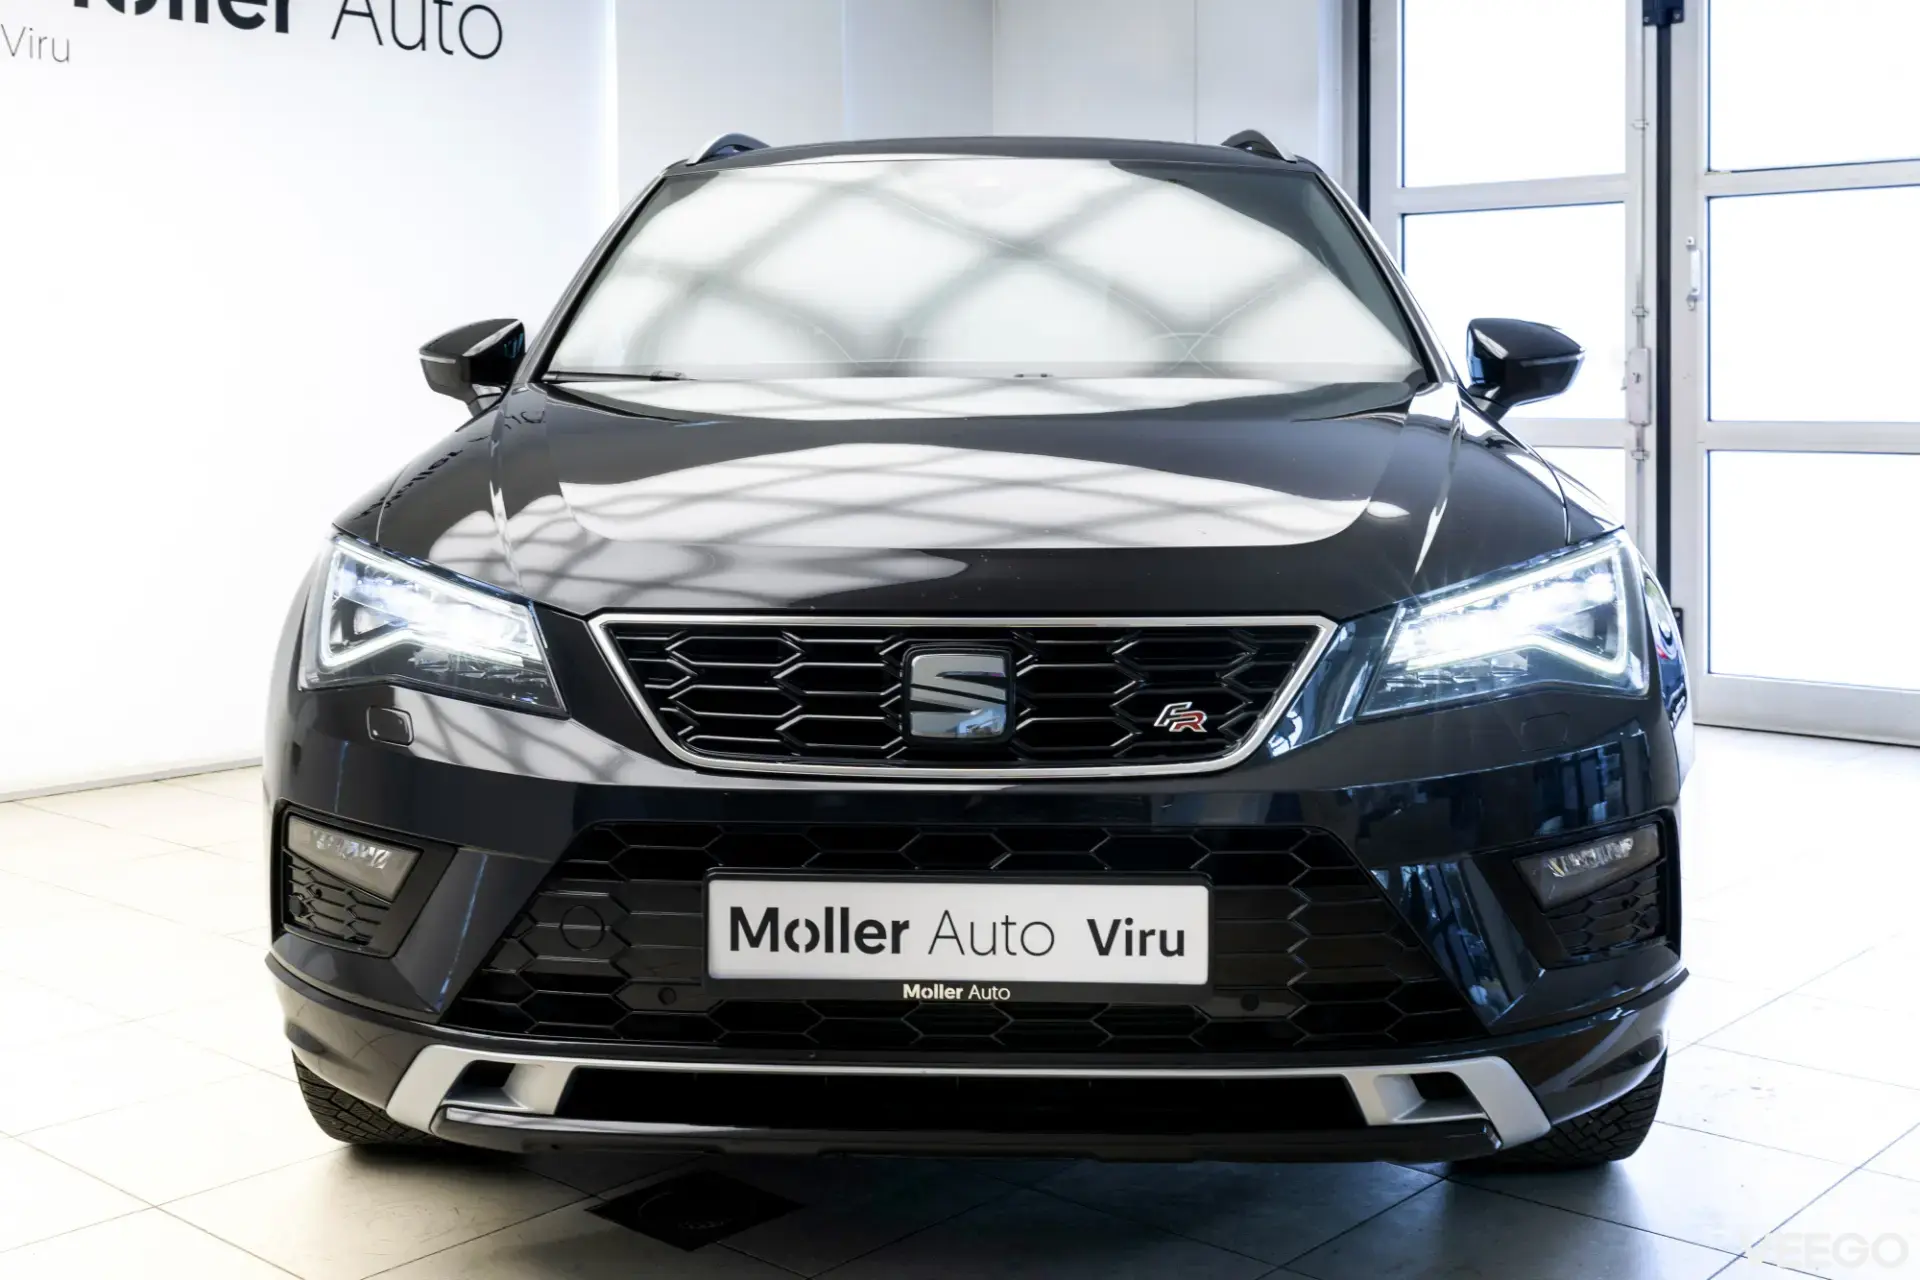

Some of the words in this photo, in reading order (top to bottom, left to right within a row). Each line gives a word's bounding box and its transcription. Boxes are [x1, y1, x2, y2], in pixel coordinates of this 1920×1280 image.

[1, 24, 70, 62] Viru
[1154, 701, 1208, 733] FR
[928, 910, 1055, 957] Auto
[1087, 918, 1185, 958] Viru
[967, 984, 1011, 1001] Auto
